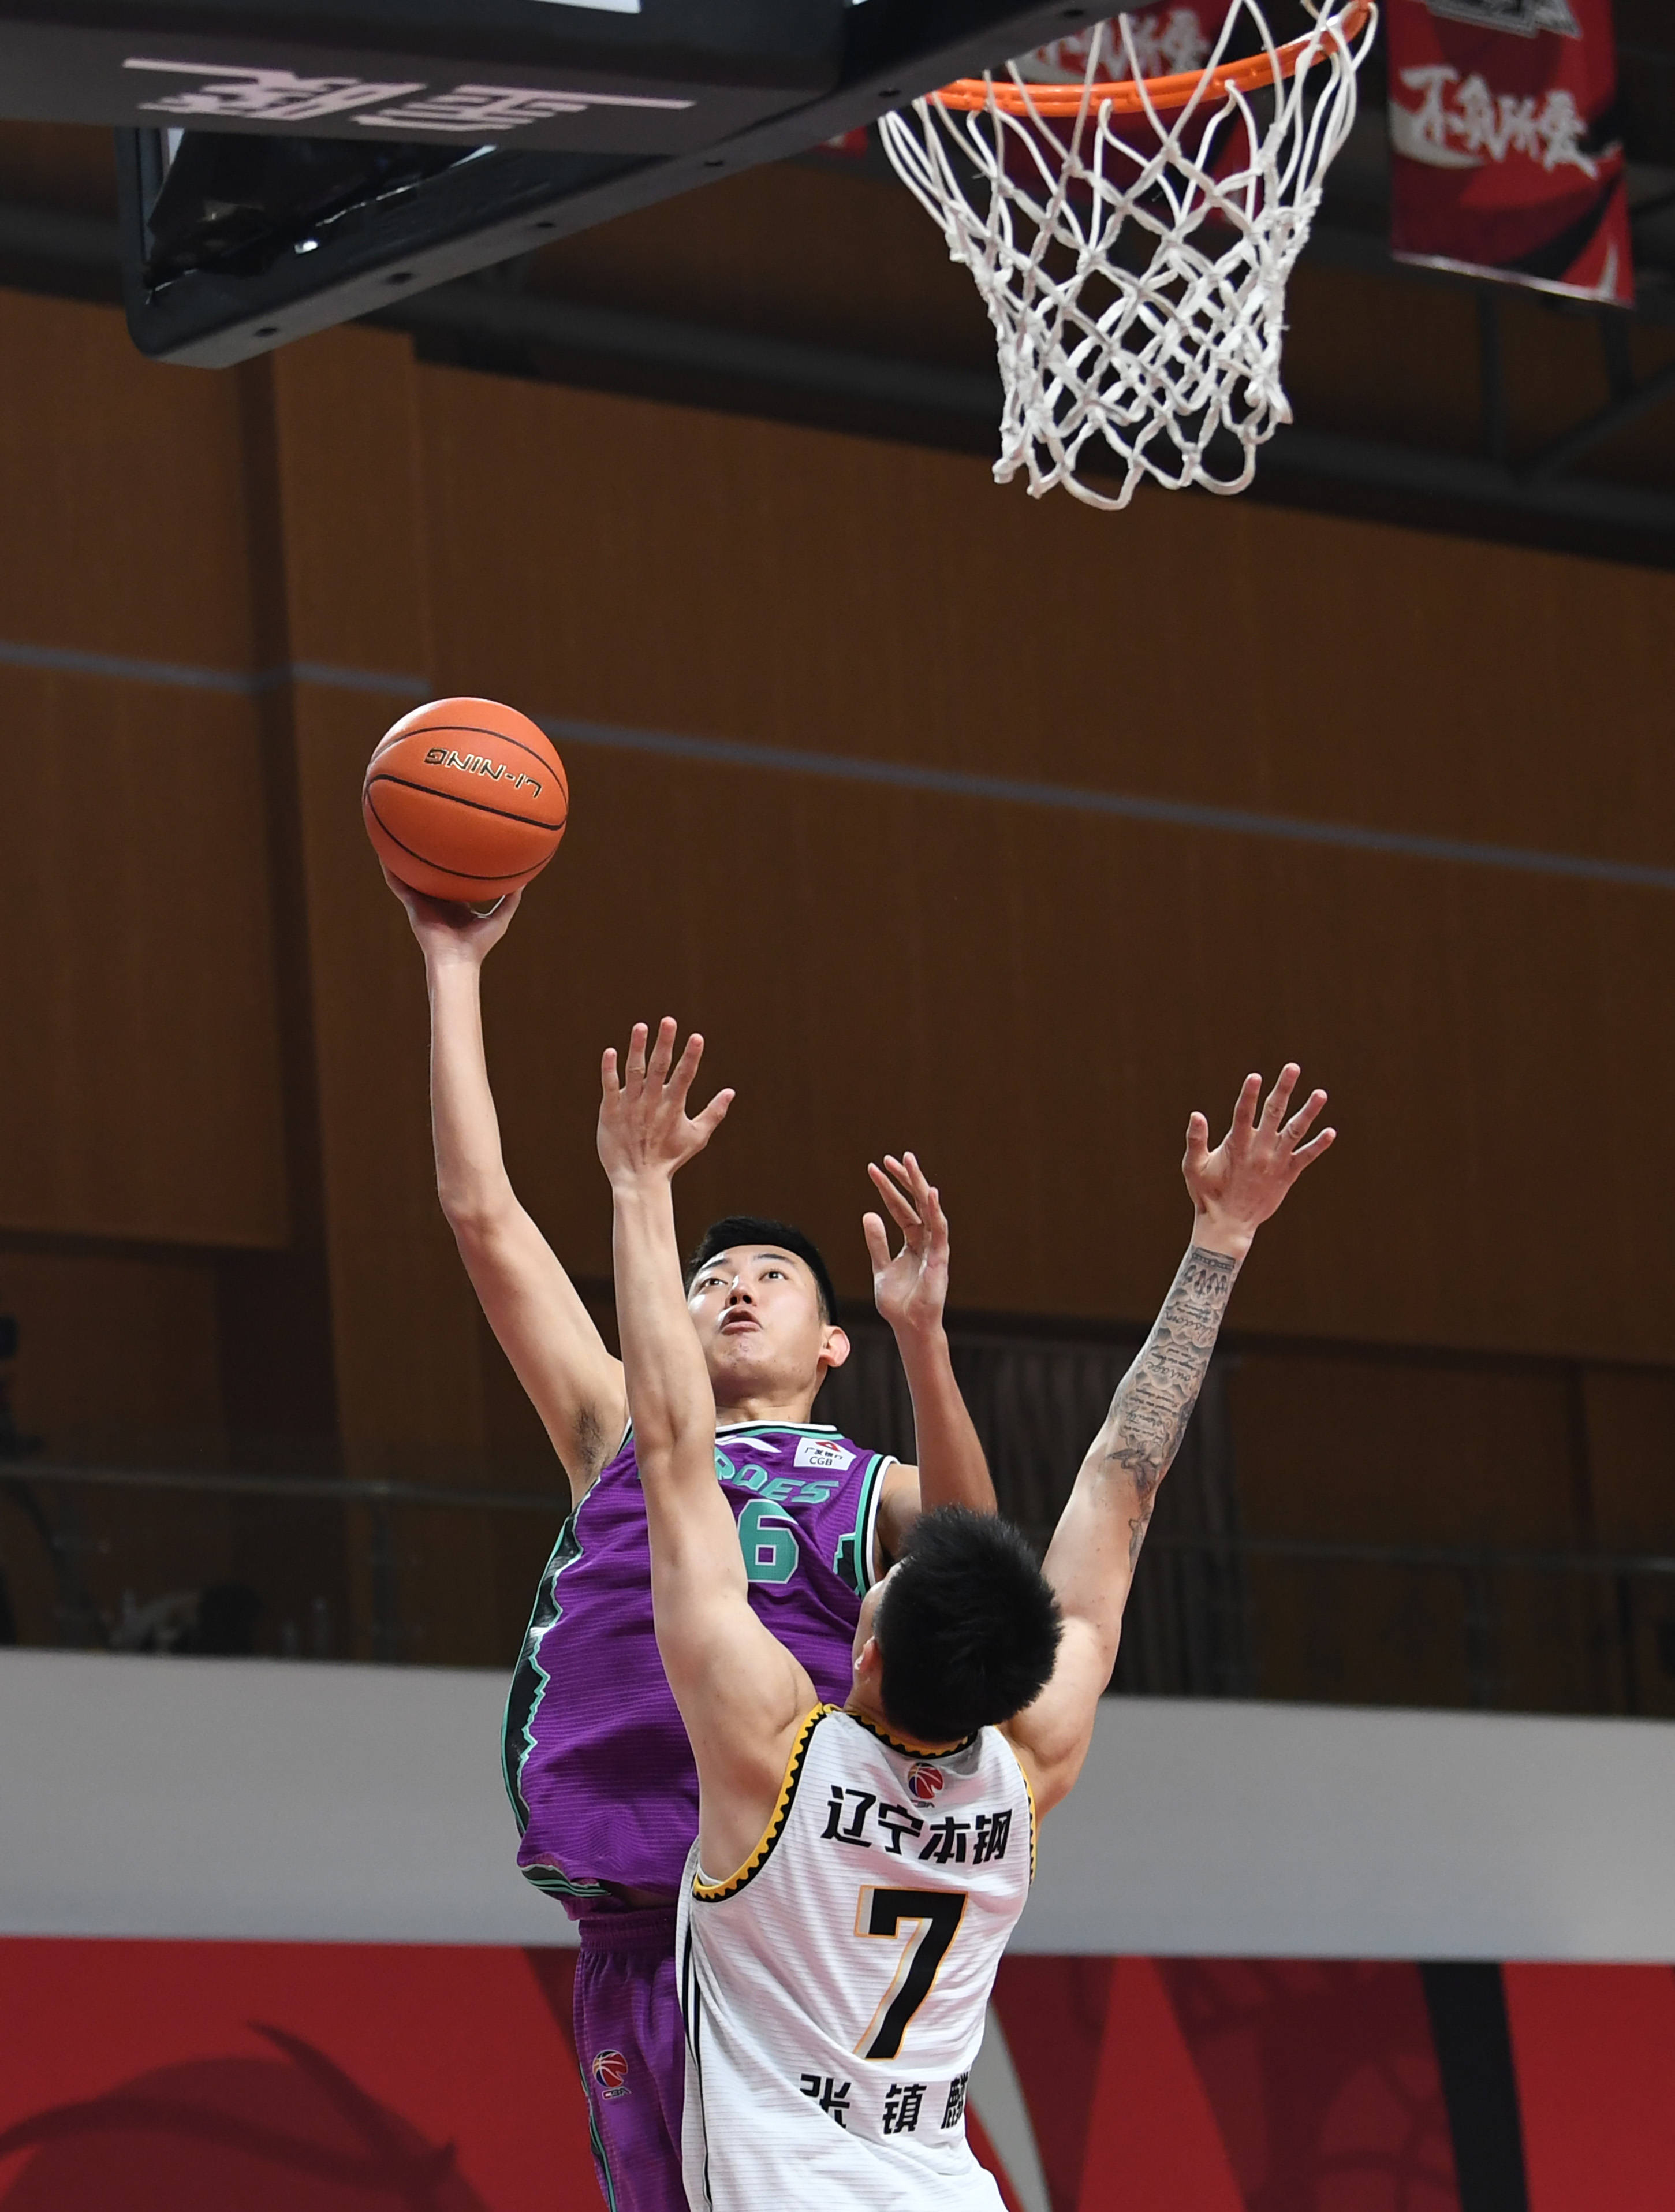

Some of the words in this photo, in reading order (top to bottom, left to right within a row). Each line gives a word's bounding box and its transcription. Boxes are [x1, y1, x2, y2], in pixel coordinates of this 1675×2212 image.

[424, 748, 542, 798] LI-NING
[809, 1456, 833, 1465] CGB
[738, 1499, 799, 1584] 6
[821, 1785, 1012, 1865] 辽宁本钢
[853, 1886, 969, 2061] 7
